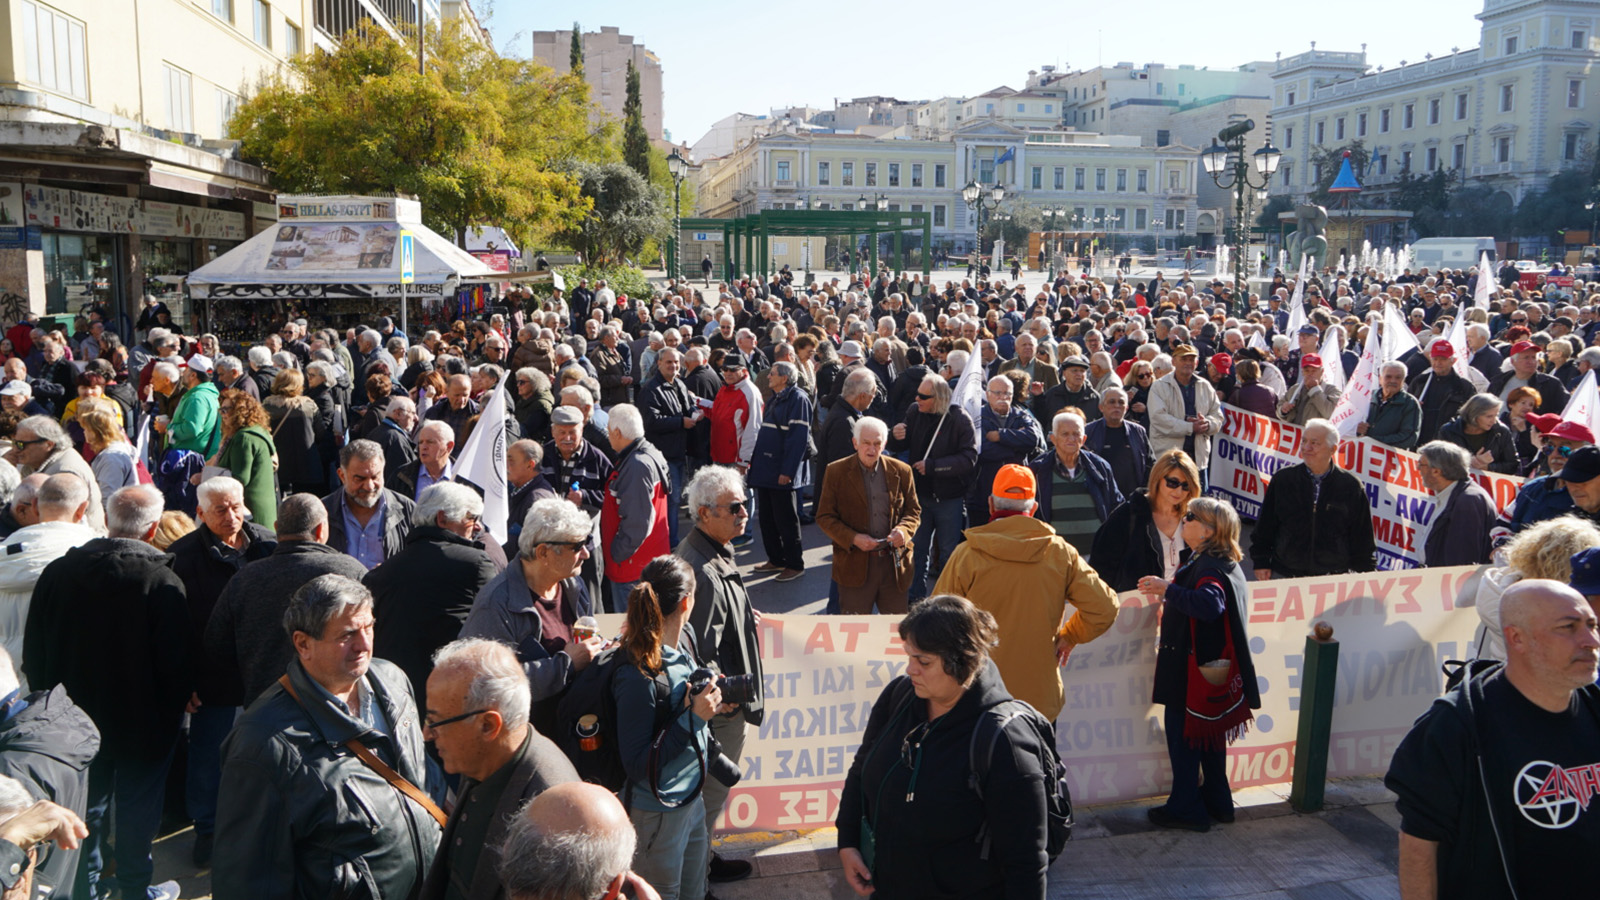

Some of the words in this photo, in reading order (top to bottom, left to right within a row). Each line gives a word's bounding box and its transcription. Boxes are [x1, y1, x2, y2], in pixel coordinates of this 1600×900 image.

[300, 204, 371, 217] HELLAS-EGYPT
[1233, 468, 1258, 495] ΓΙΑ
[1372, 515, 1416, 553] ΜΑΣ
[1528, 762, 1600, 812] ANTH
